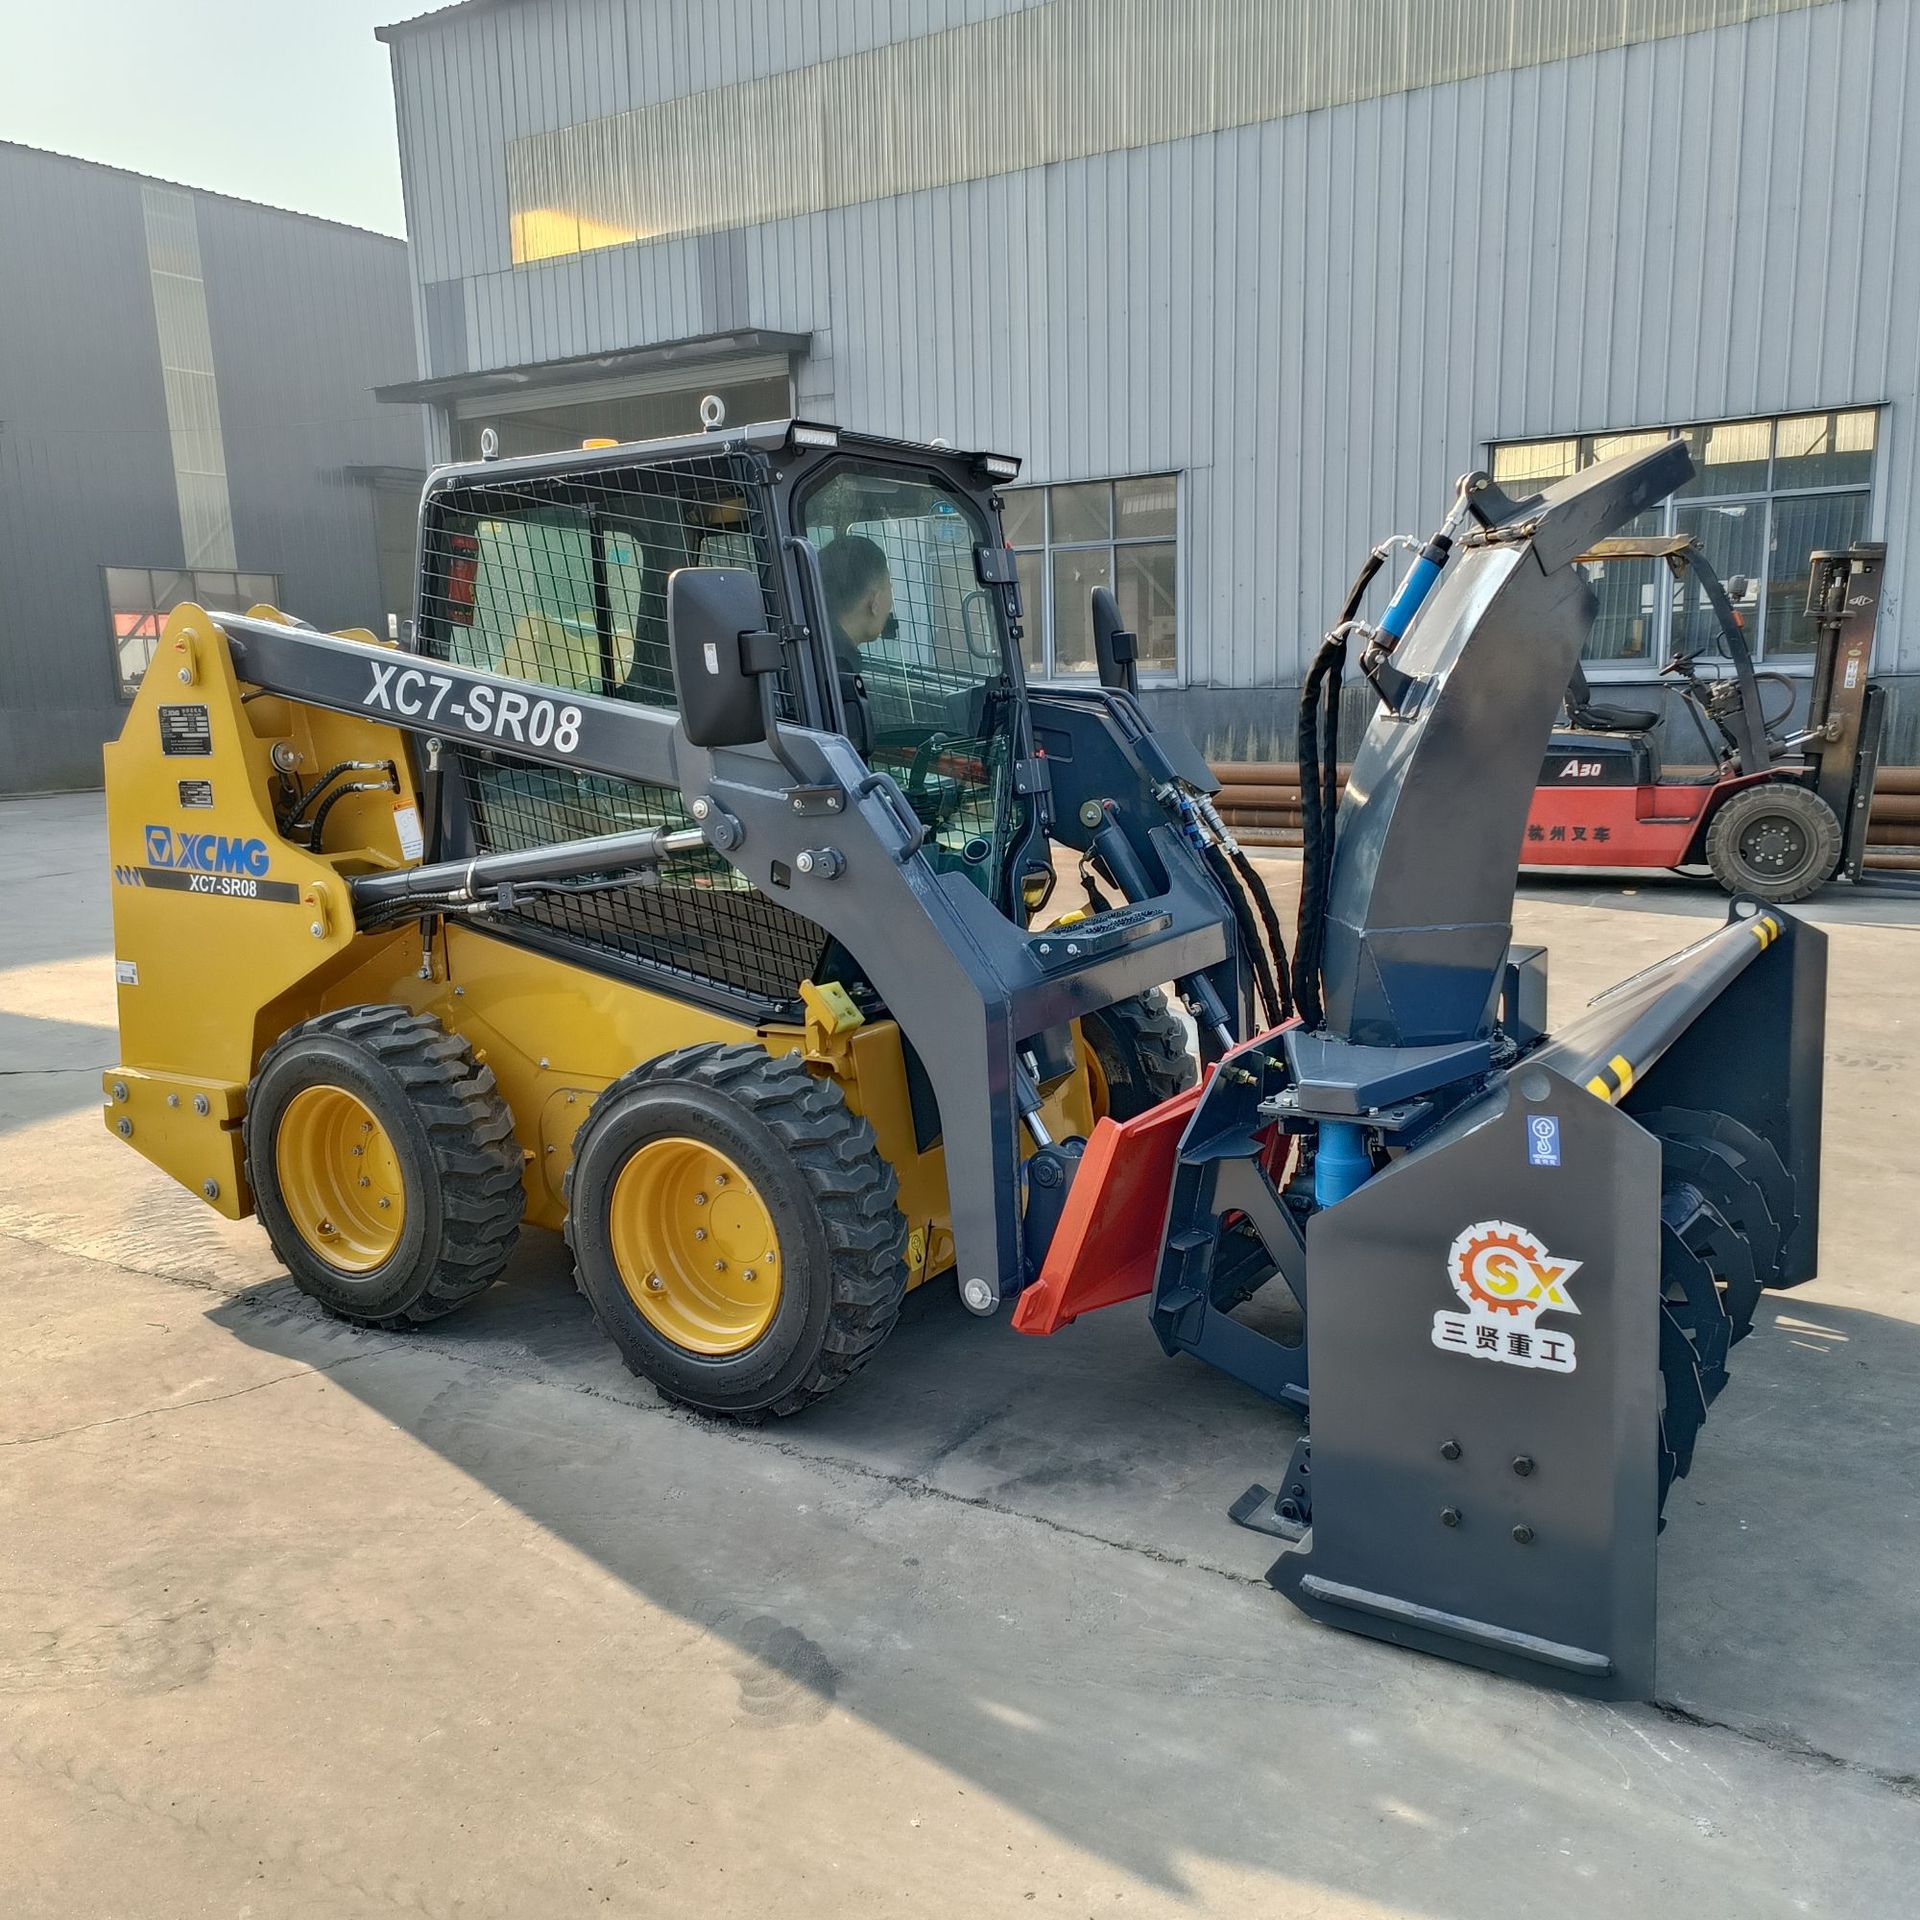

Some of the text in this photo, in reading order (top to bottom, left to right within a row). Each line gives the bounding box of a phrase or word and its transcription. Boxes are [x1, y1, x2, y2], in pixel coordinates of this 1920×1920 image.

[363, 662, 583, 753] XC7-SR08
[1558, 760, 1602, 777] A30
[174, 832, 270, 877] XCMG
[1527, 825, 1611, 842] 杭州叉车
[189, 873, 257, 898] XC7-SR08
[1485, 1253, 1566, 1304] SX
[1442, 1320, 1567, 1364] 三贤重工
